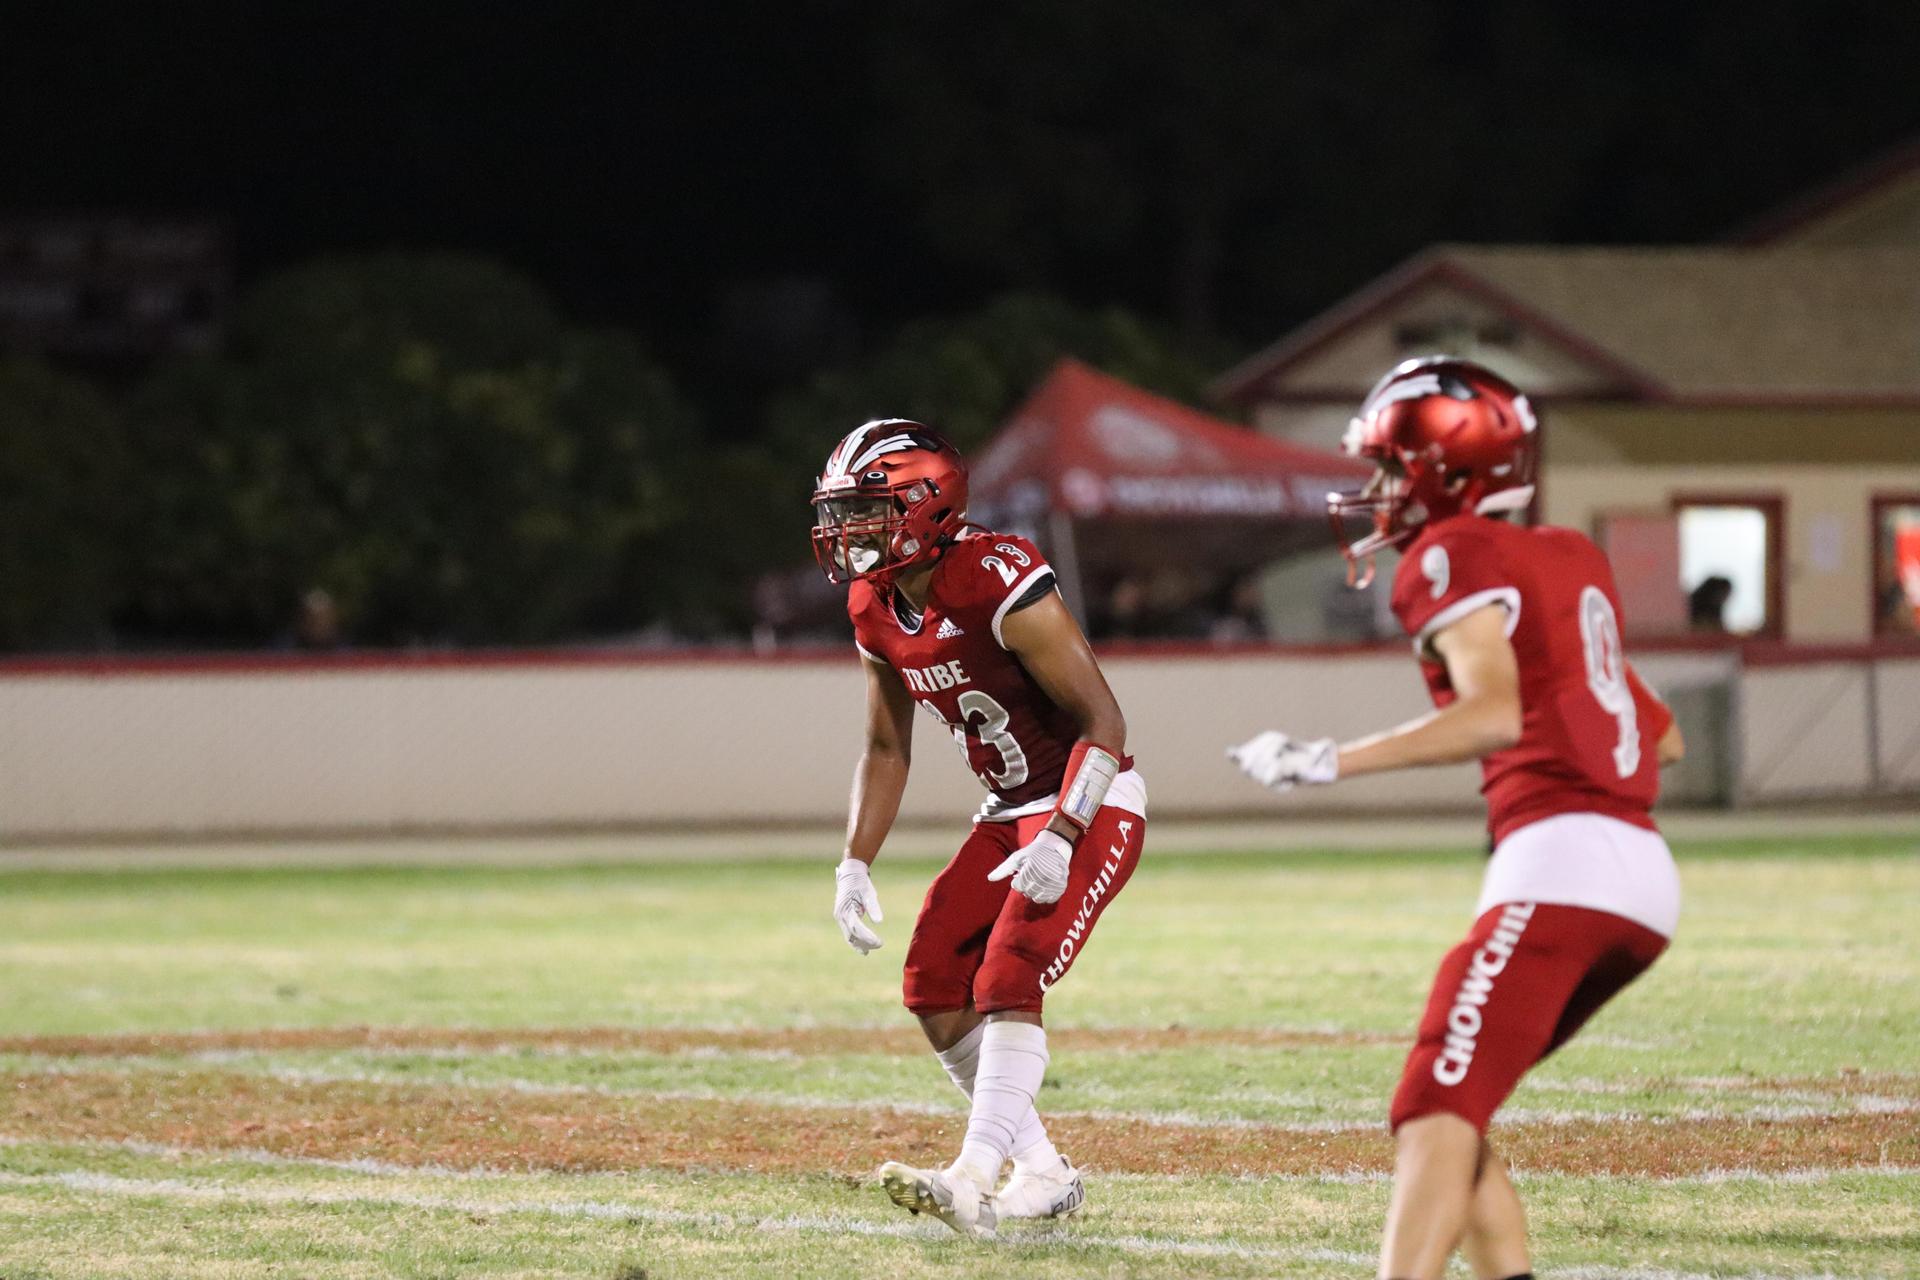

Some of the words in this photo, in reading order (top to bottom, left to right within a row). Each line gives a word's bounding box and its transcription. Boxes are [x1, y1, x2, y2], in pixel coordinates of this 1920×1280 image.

[981, 542, 1031, 588] 23
[1421, 544, 1450, 599] 9
[936, 628, 965, 640] adidas
[902, 659, 972, 692] TRIBE
[1579, 585, 1641, 778] 9
[1038, 819, 1133, 993] CHOWCHILLA
